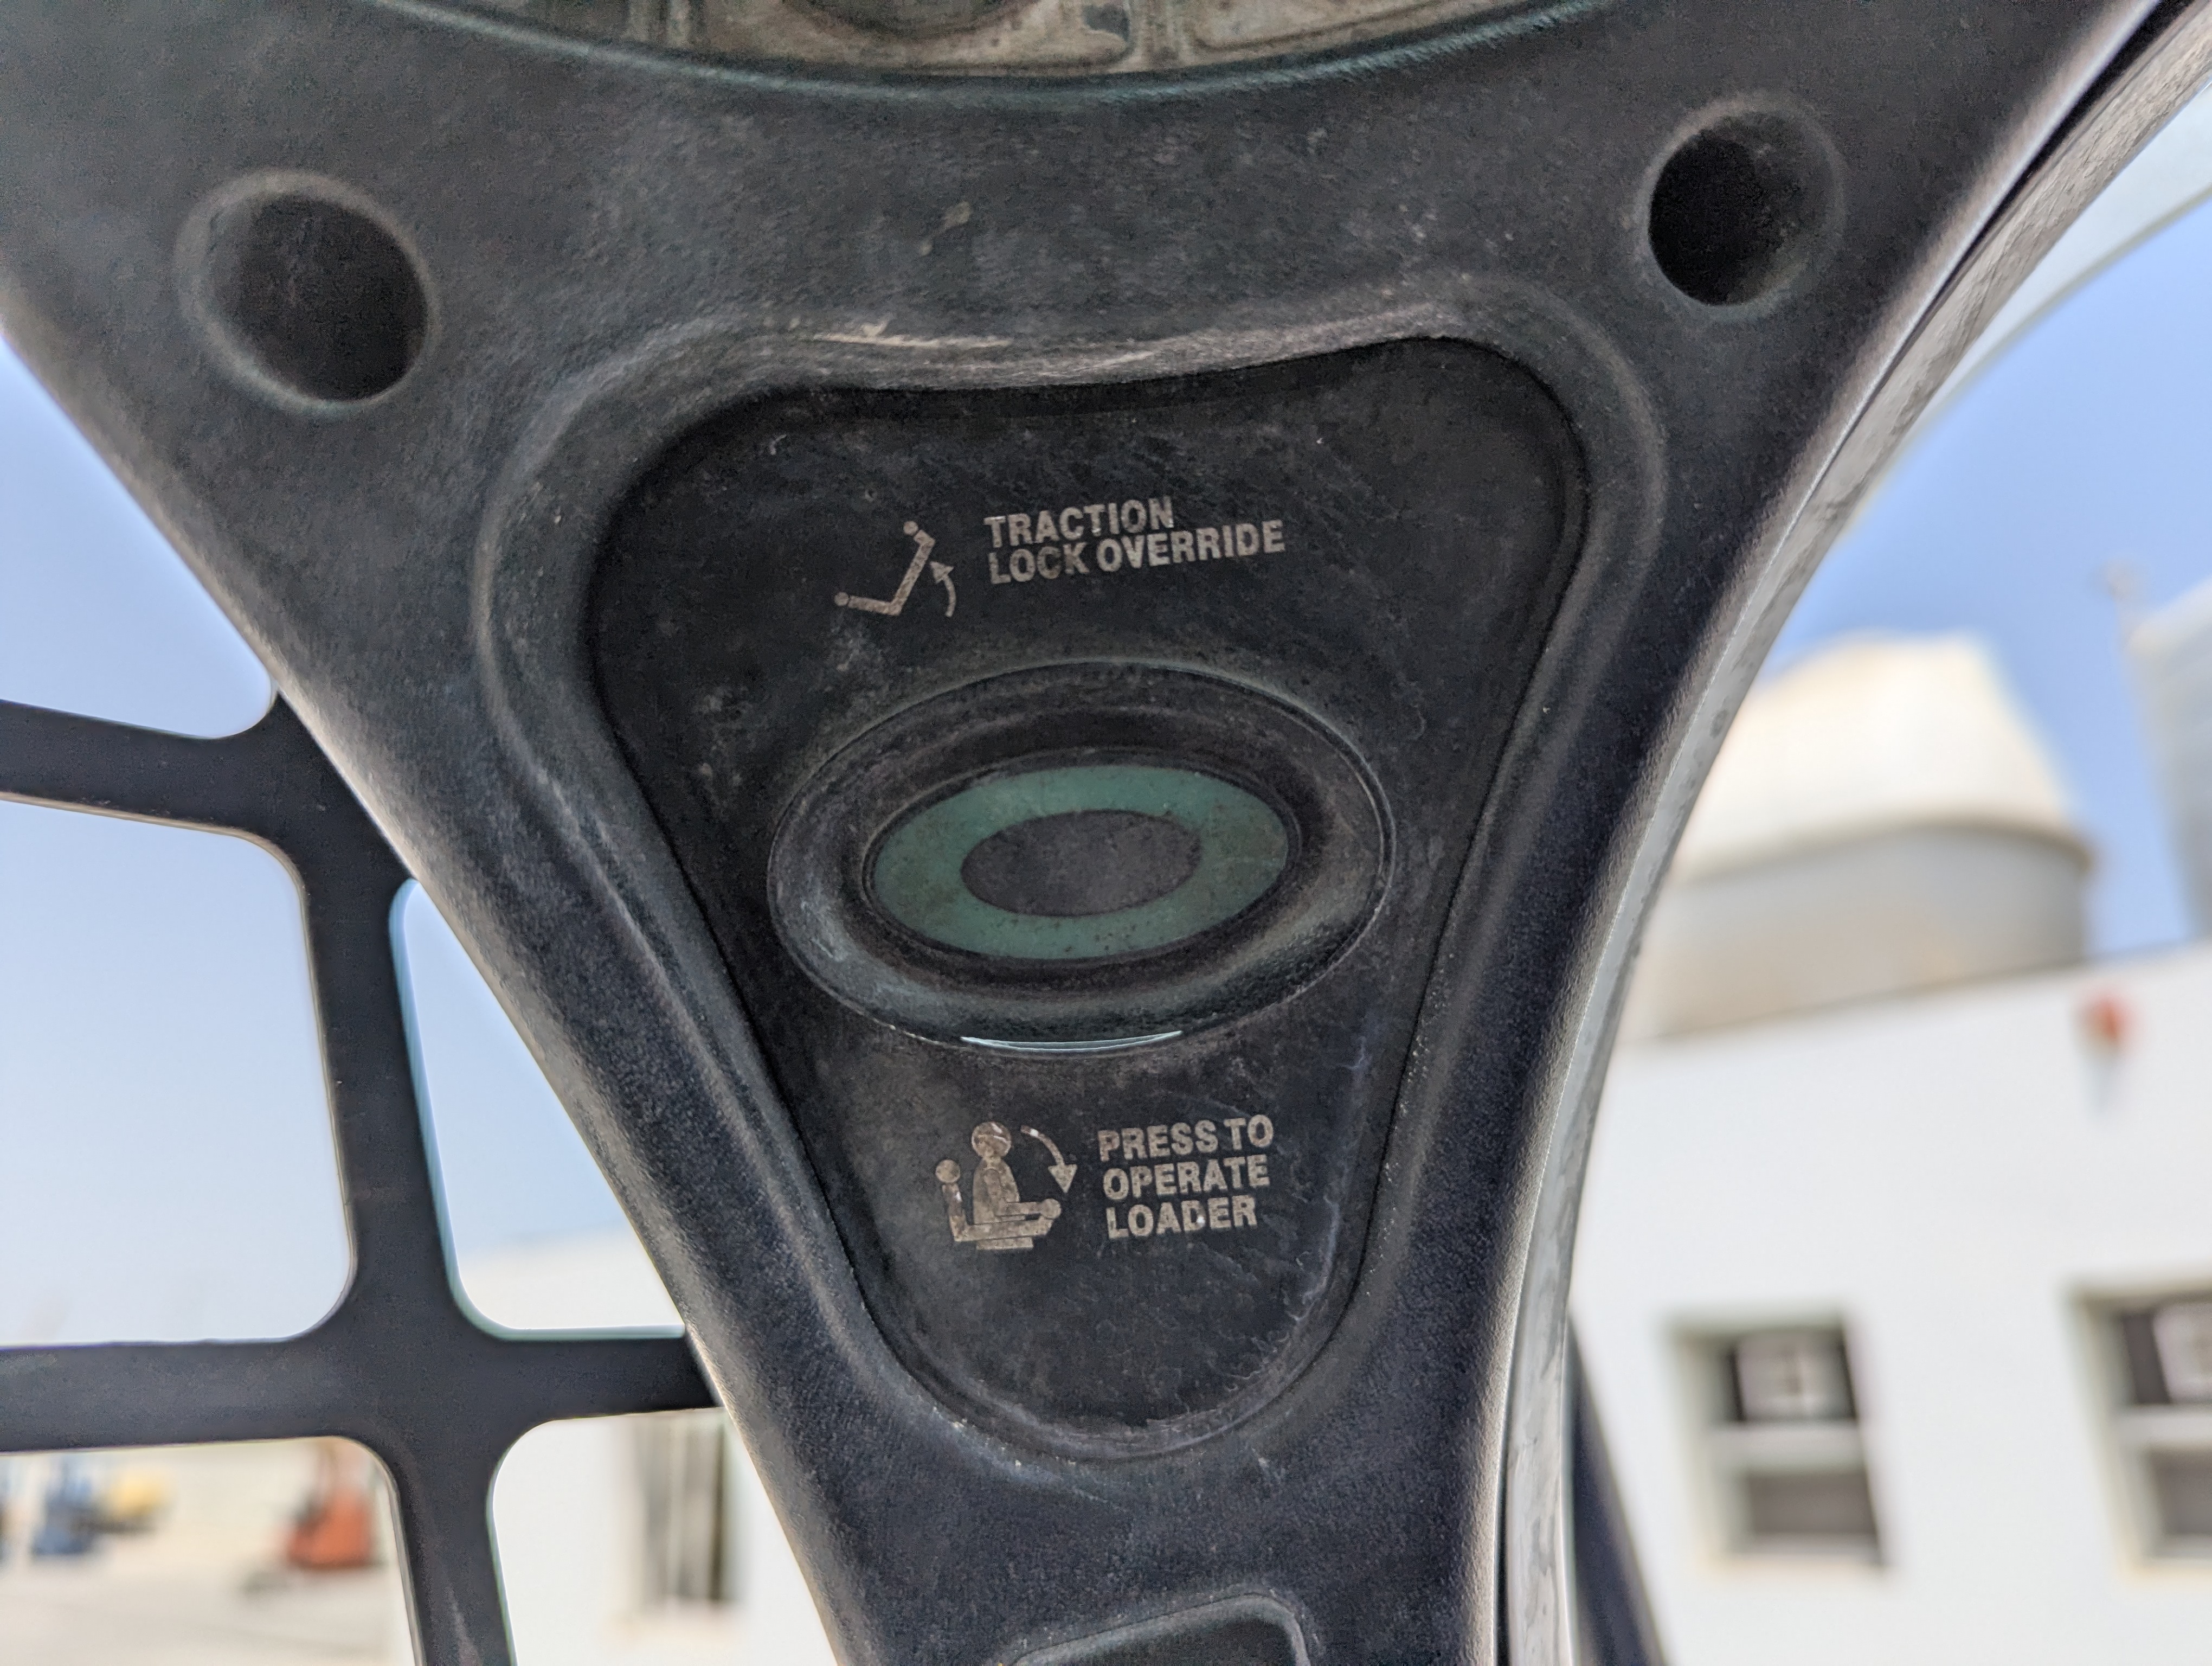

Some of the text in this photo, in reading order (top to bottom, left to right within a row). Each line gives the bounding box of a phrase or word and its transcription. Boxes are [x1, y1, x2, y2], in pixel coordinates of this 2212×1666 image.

[983, 495, 1174, 548] TRACTION
[988, 519, 1286, 585] LOCK OVERRIDE
[1097, 1114, 1274, 1162] PRESS TO
[1103, 1154, 1270, 1200] OPERATE
[1105, 1194, 1257, 1239] LOADER
